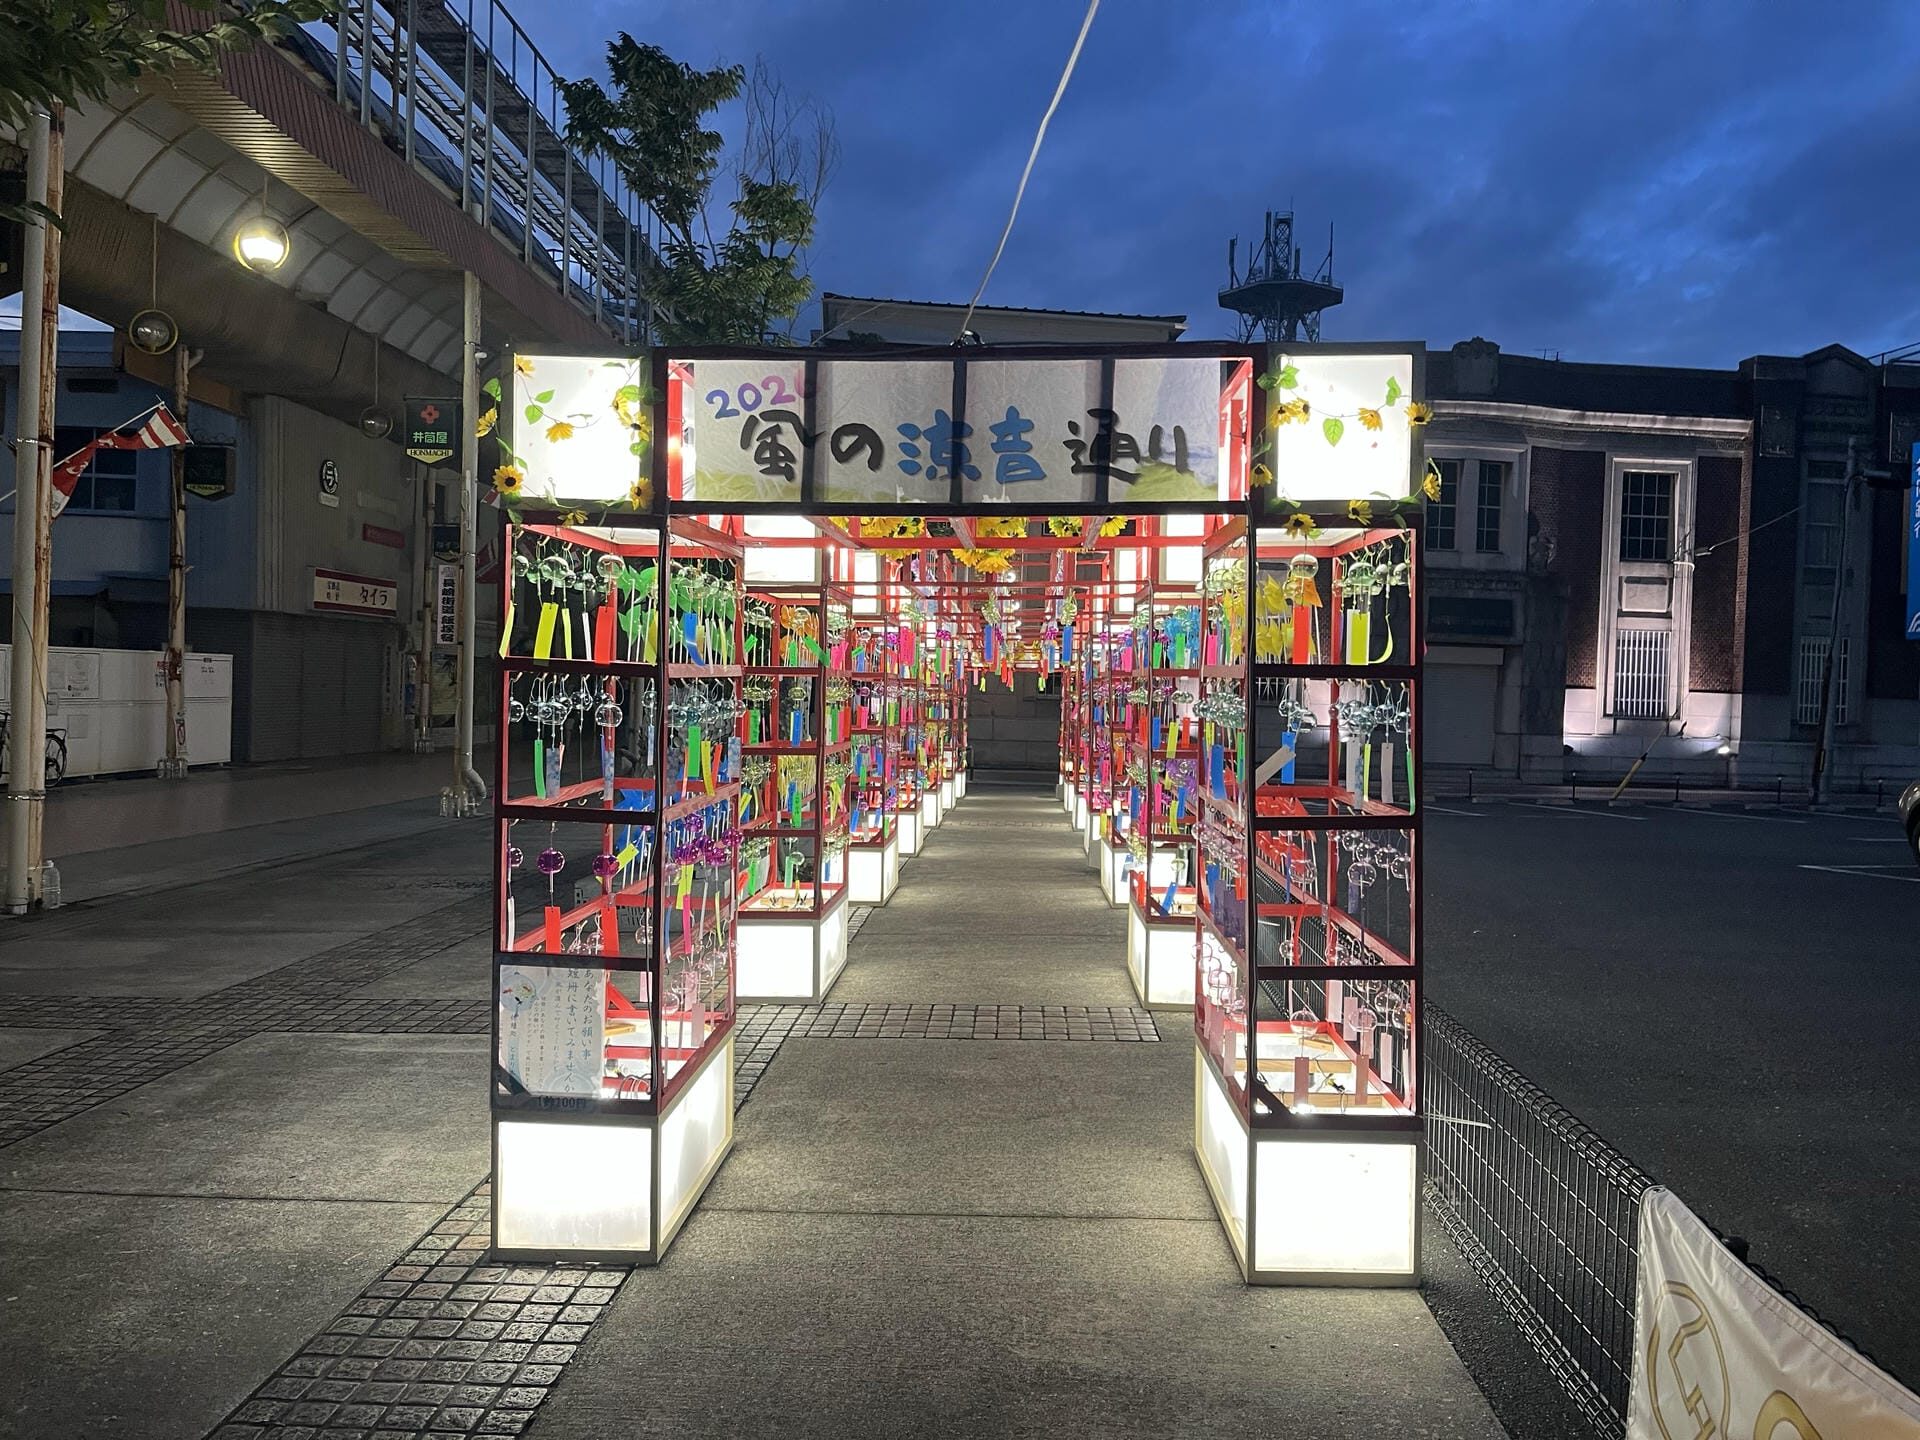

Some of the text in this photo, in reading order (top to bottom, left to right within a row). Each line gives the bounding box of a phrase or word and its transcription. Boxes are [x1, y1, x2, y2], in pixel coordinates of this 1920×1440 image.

[412, 431, 449, 444] 井筒屋
[740, 405, 1188, 486] 風の涼音通り
[410, 449, 449, 457] HONMACHI
[359, 586, 388, 606] タイラ
